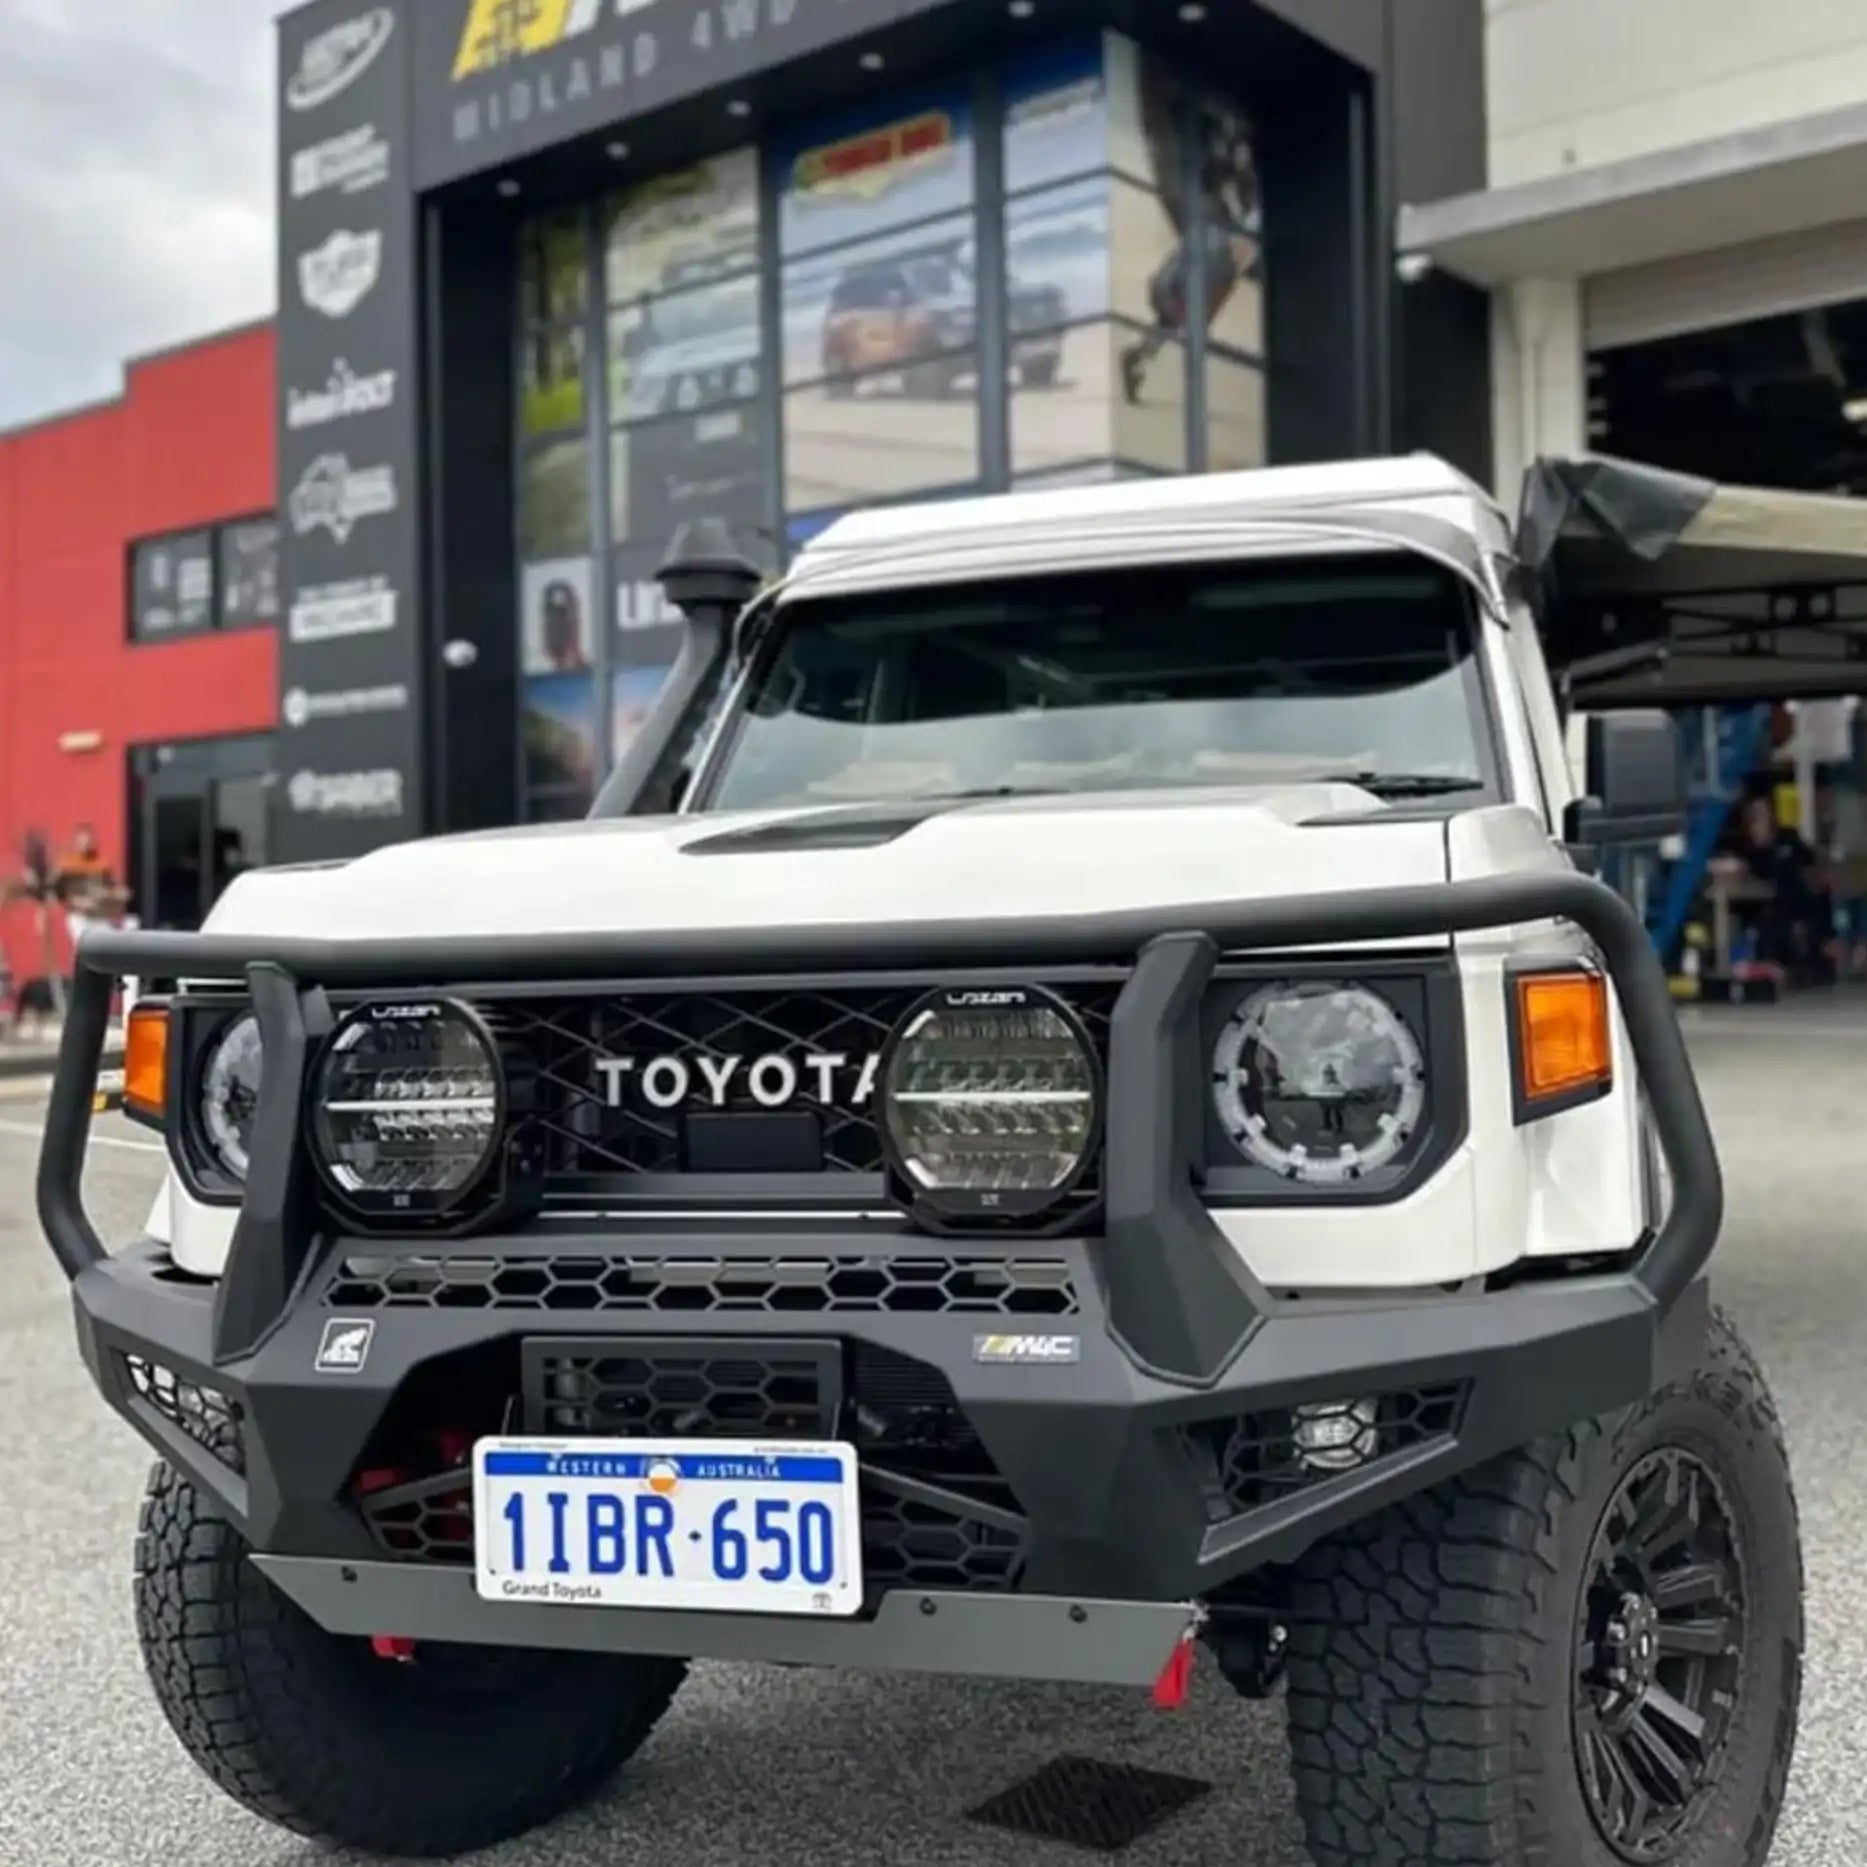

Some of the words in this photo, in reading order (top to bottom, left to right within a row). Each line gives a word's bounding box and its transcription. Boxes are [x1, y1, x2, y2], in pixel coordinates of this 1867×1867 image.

[453, 32, 655, 140] MIDLAND
[546, 1460, 626, 1475] WESTERN
[697, 1463, 781, 1479] AUSTRALIA
[502, 1579, 549, 1596] Grand
[553, 1582, 602, 1601] Toyota
